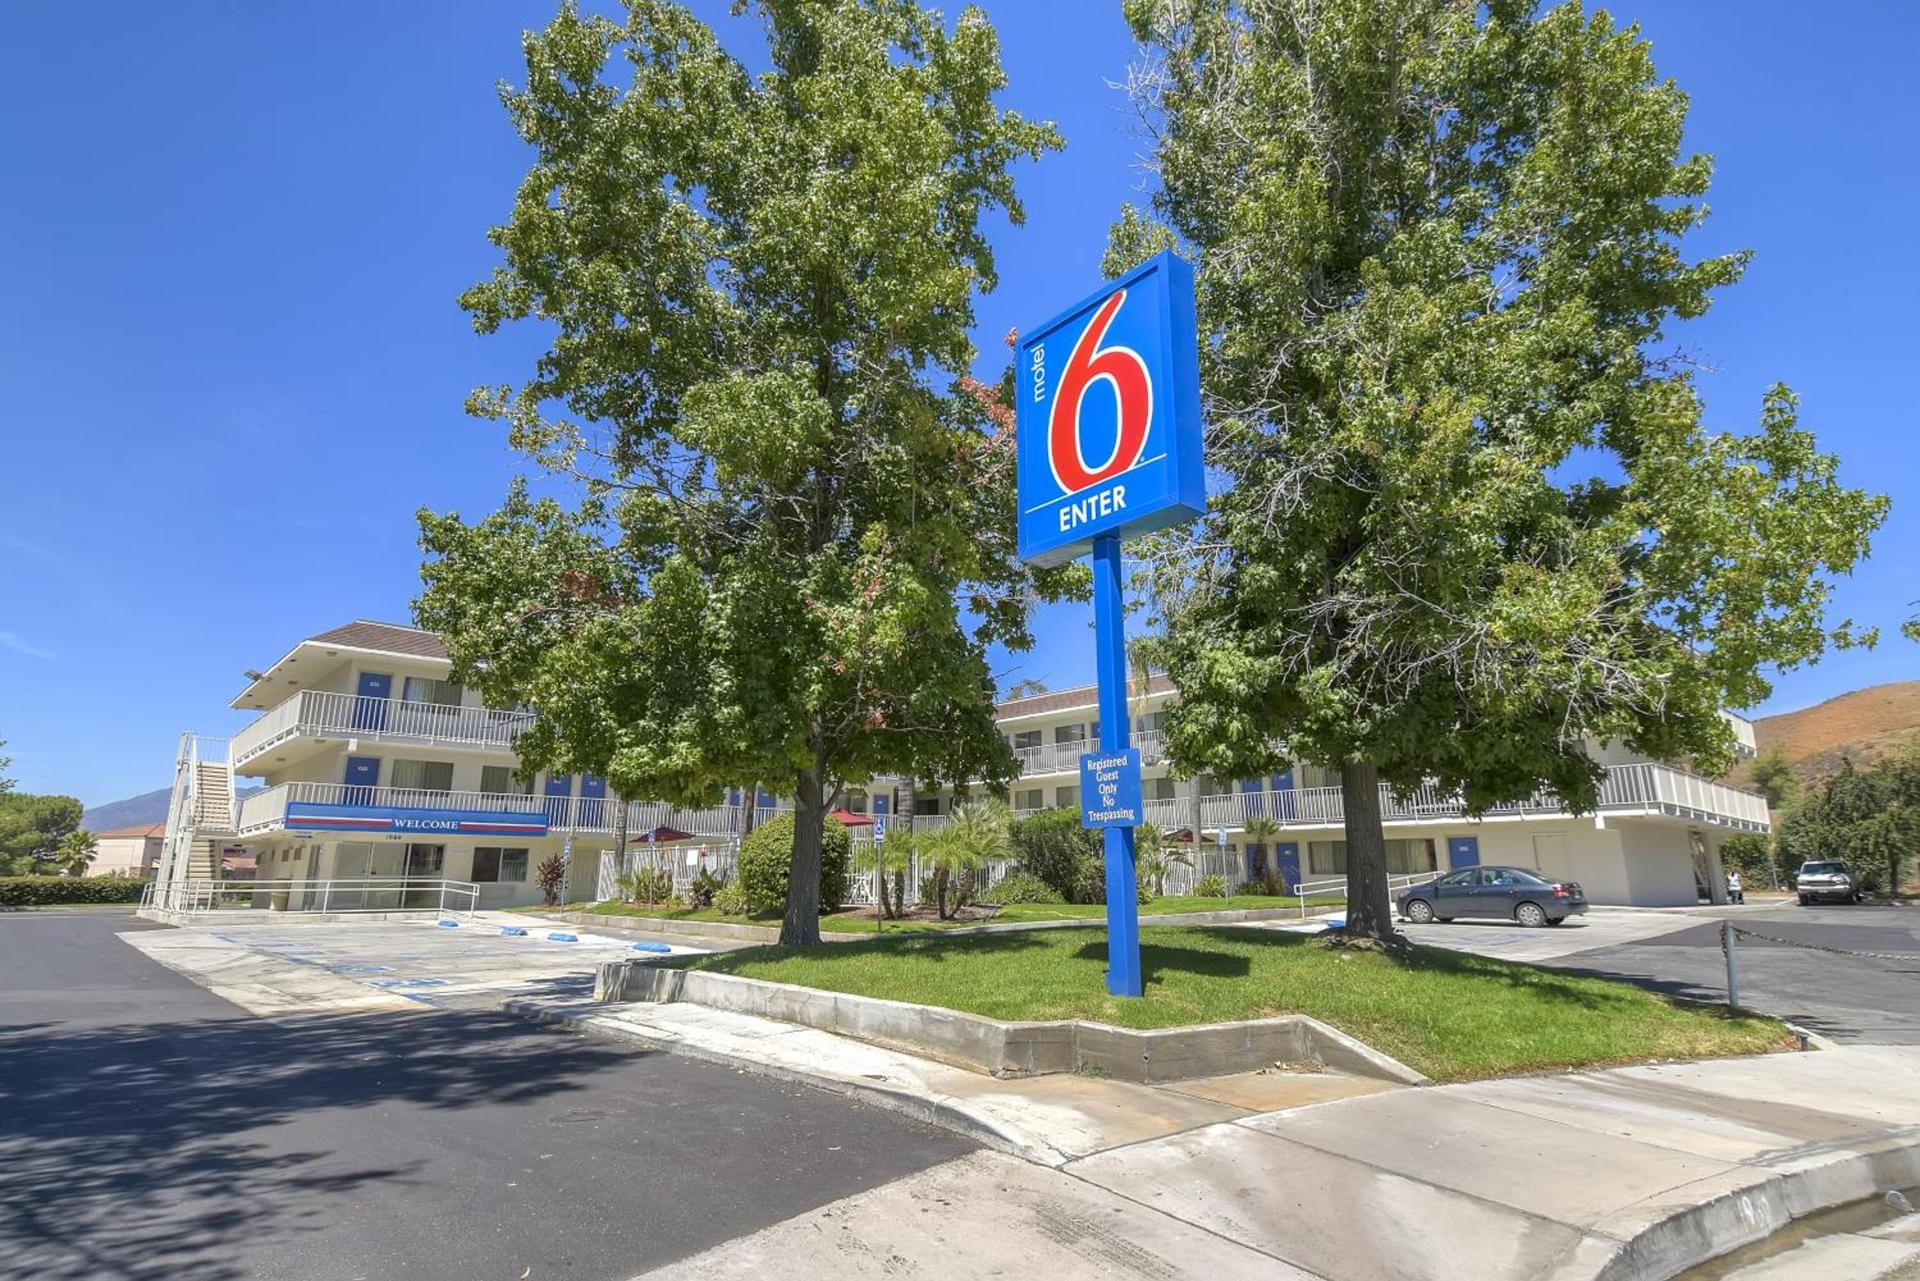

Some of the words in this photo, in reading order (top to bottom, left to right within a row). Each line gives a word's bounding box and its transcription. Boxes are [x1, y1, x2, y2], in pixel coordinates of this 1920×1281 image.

[1031, 343, 1045, 402] motel
[1048, 288, 1153, 496] 6
[1059, 485, 1127, 532] ENTER
[1087, 755, 1127, 770] Registered
[1096, 771, 1118, 781] Guest
[1099, 783, 1117, 796] Only
[1103, 796, 1114, 807] No
[1088, 808, 1135, 822] Trespassing
[394, 819, 458, 830] WELCOME
